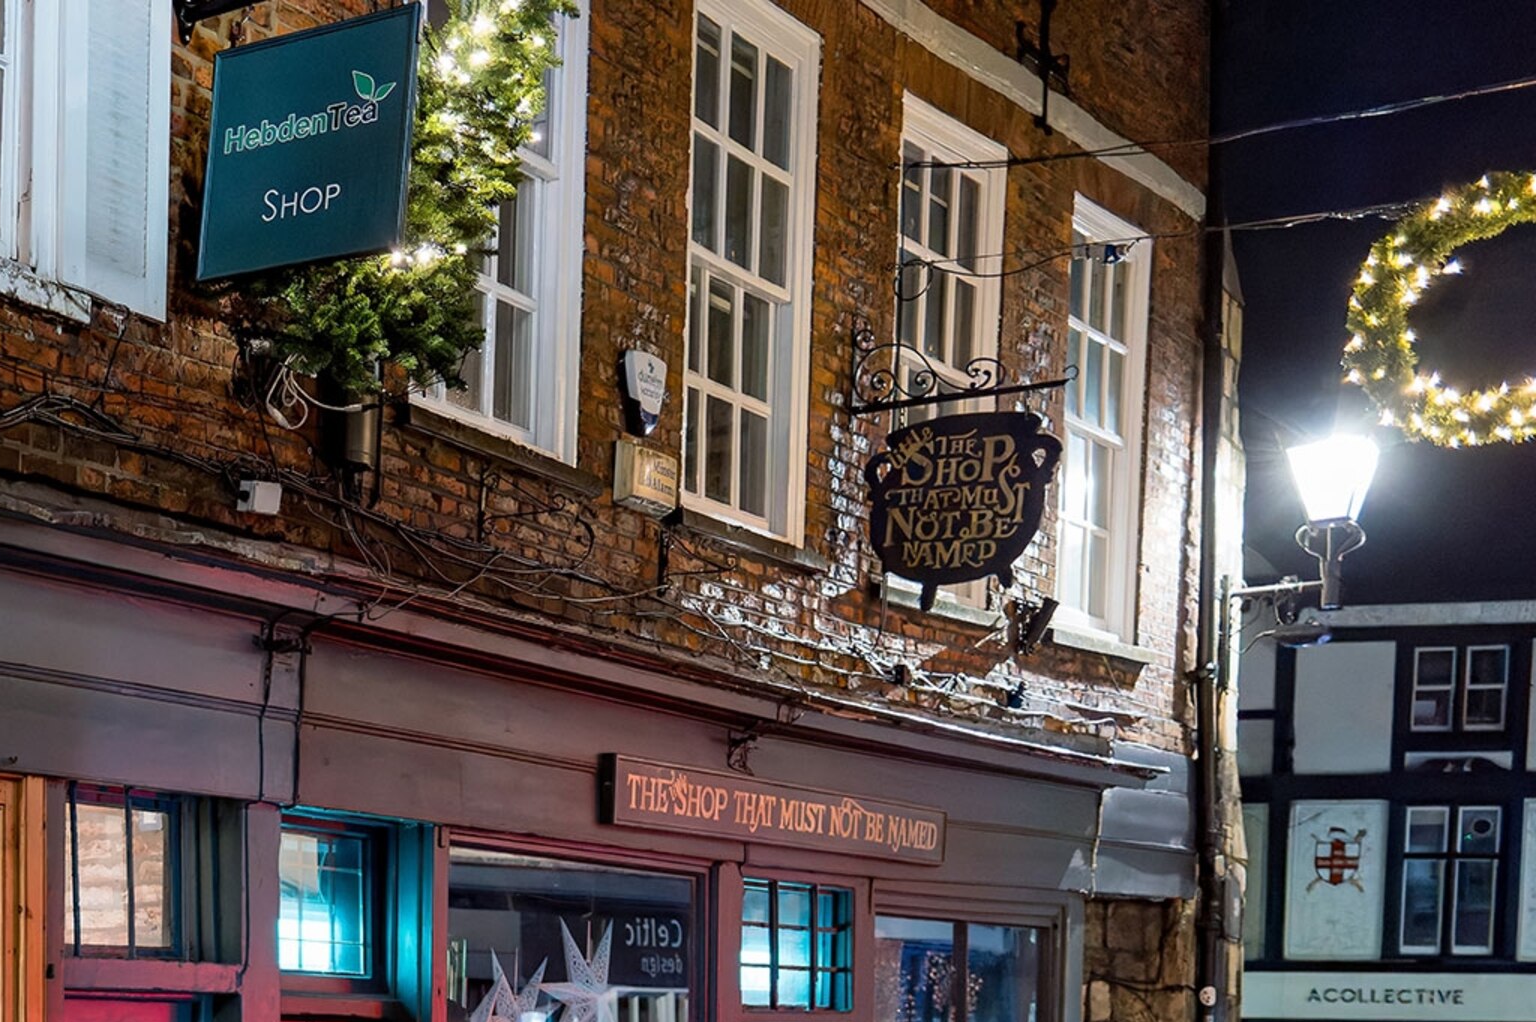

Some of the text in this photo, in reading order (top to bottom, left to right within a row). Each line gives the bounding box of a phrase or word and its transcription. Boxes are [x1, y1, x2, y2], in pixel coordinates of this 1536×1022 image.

[224, 100, 379, 155] HebdenTea
[261, 183, 341, 222] SHOP
[900, 434, 1016, 487] SHOP
[935, 428, 983, 458] THE
[884, 486, 961, 511] THAT
[882, 506, 1019, 548] NOT BE
[902, 540, 997, 570] NAMED
[627, 772, 938, 852] THE SHOP THAT MUST NOT BE NAMED
[1306, 987, 1465, 1005] ACOLLECTIVE
